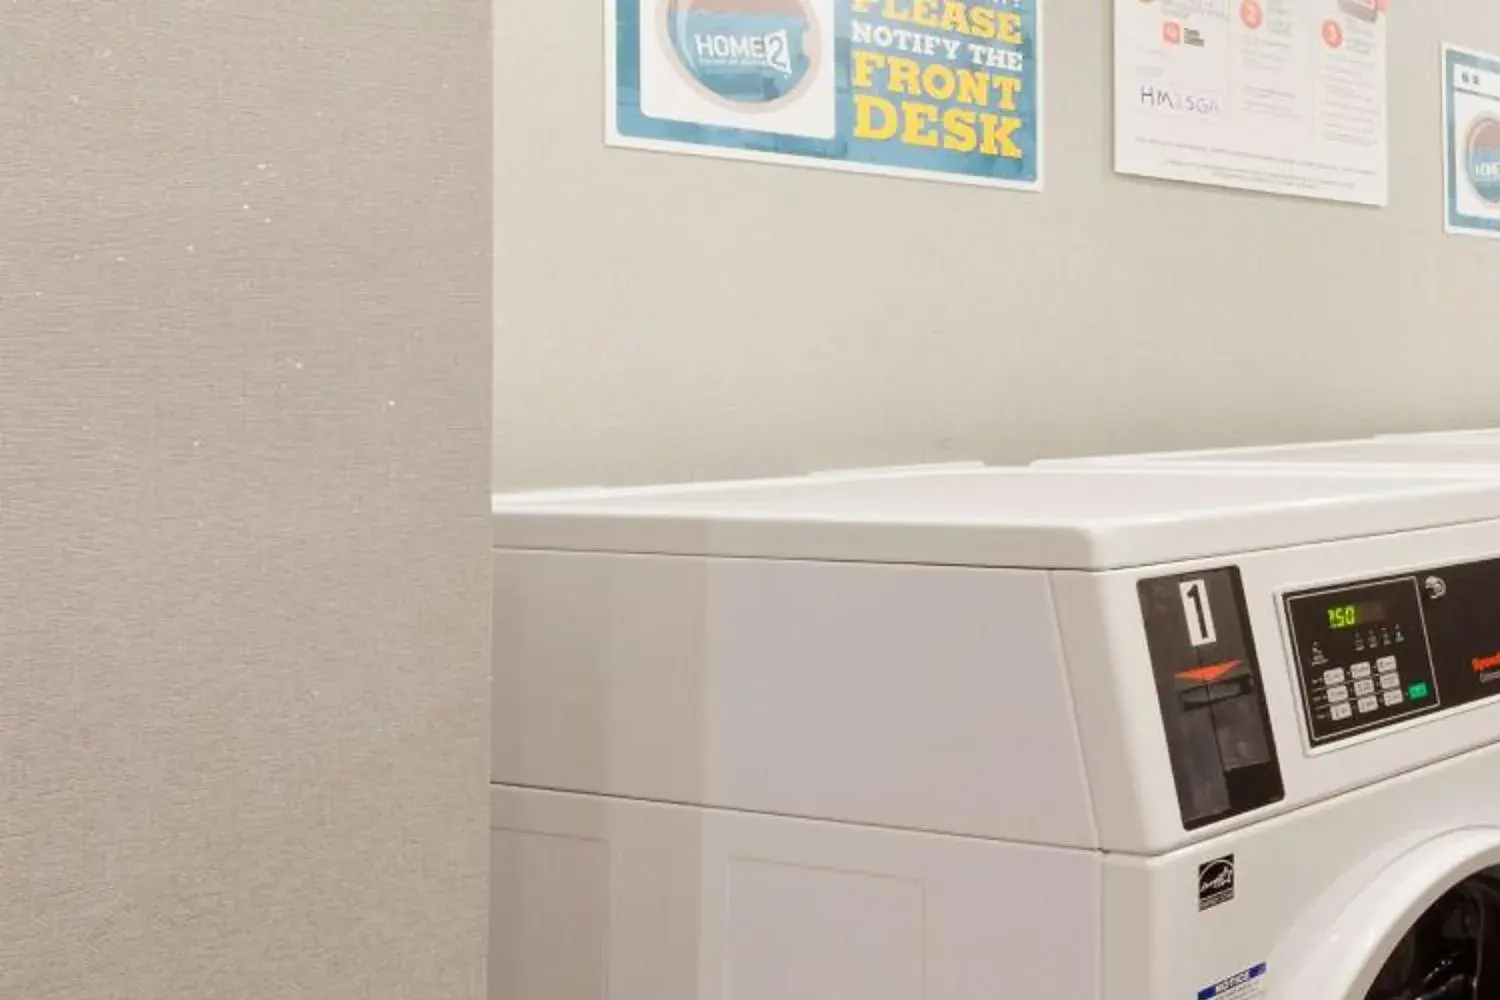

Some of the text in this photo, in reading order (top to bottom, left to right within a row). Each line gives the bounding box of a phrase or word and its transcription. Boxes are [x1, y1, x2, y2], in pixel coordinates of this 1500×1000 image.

[851, 20, 1024, 72] NOTIFY THE
[851, 48, 1022, 111] FRONT
[852, 93, 1023, 159] DESK
[1186, 583, 1209, 639] 1
